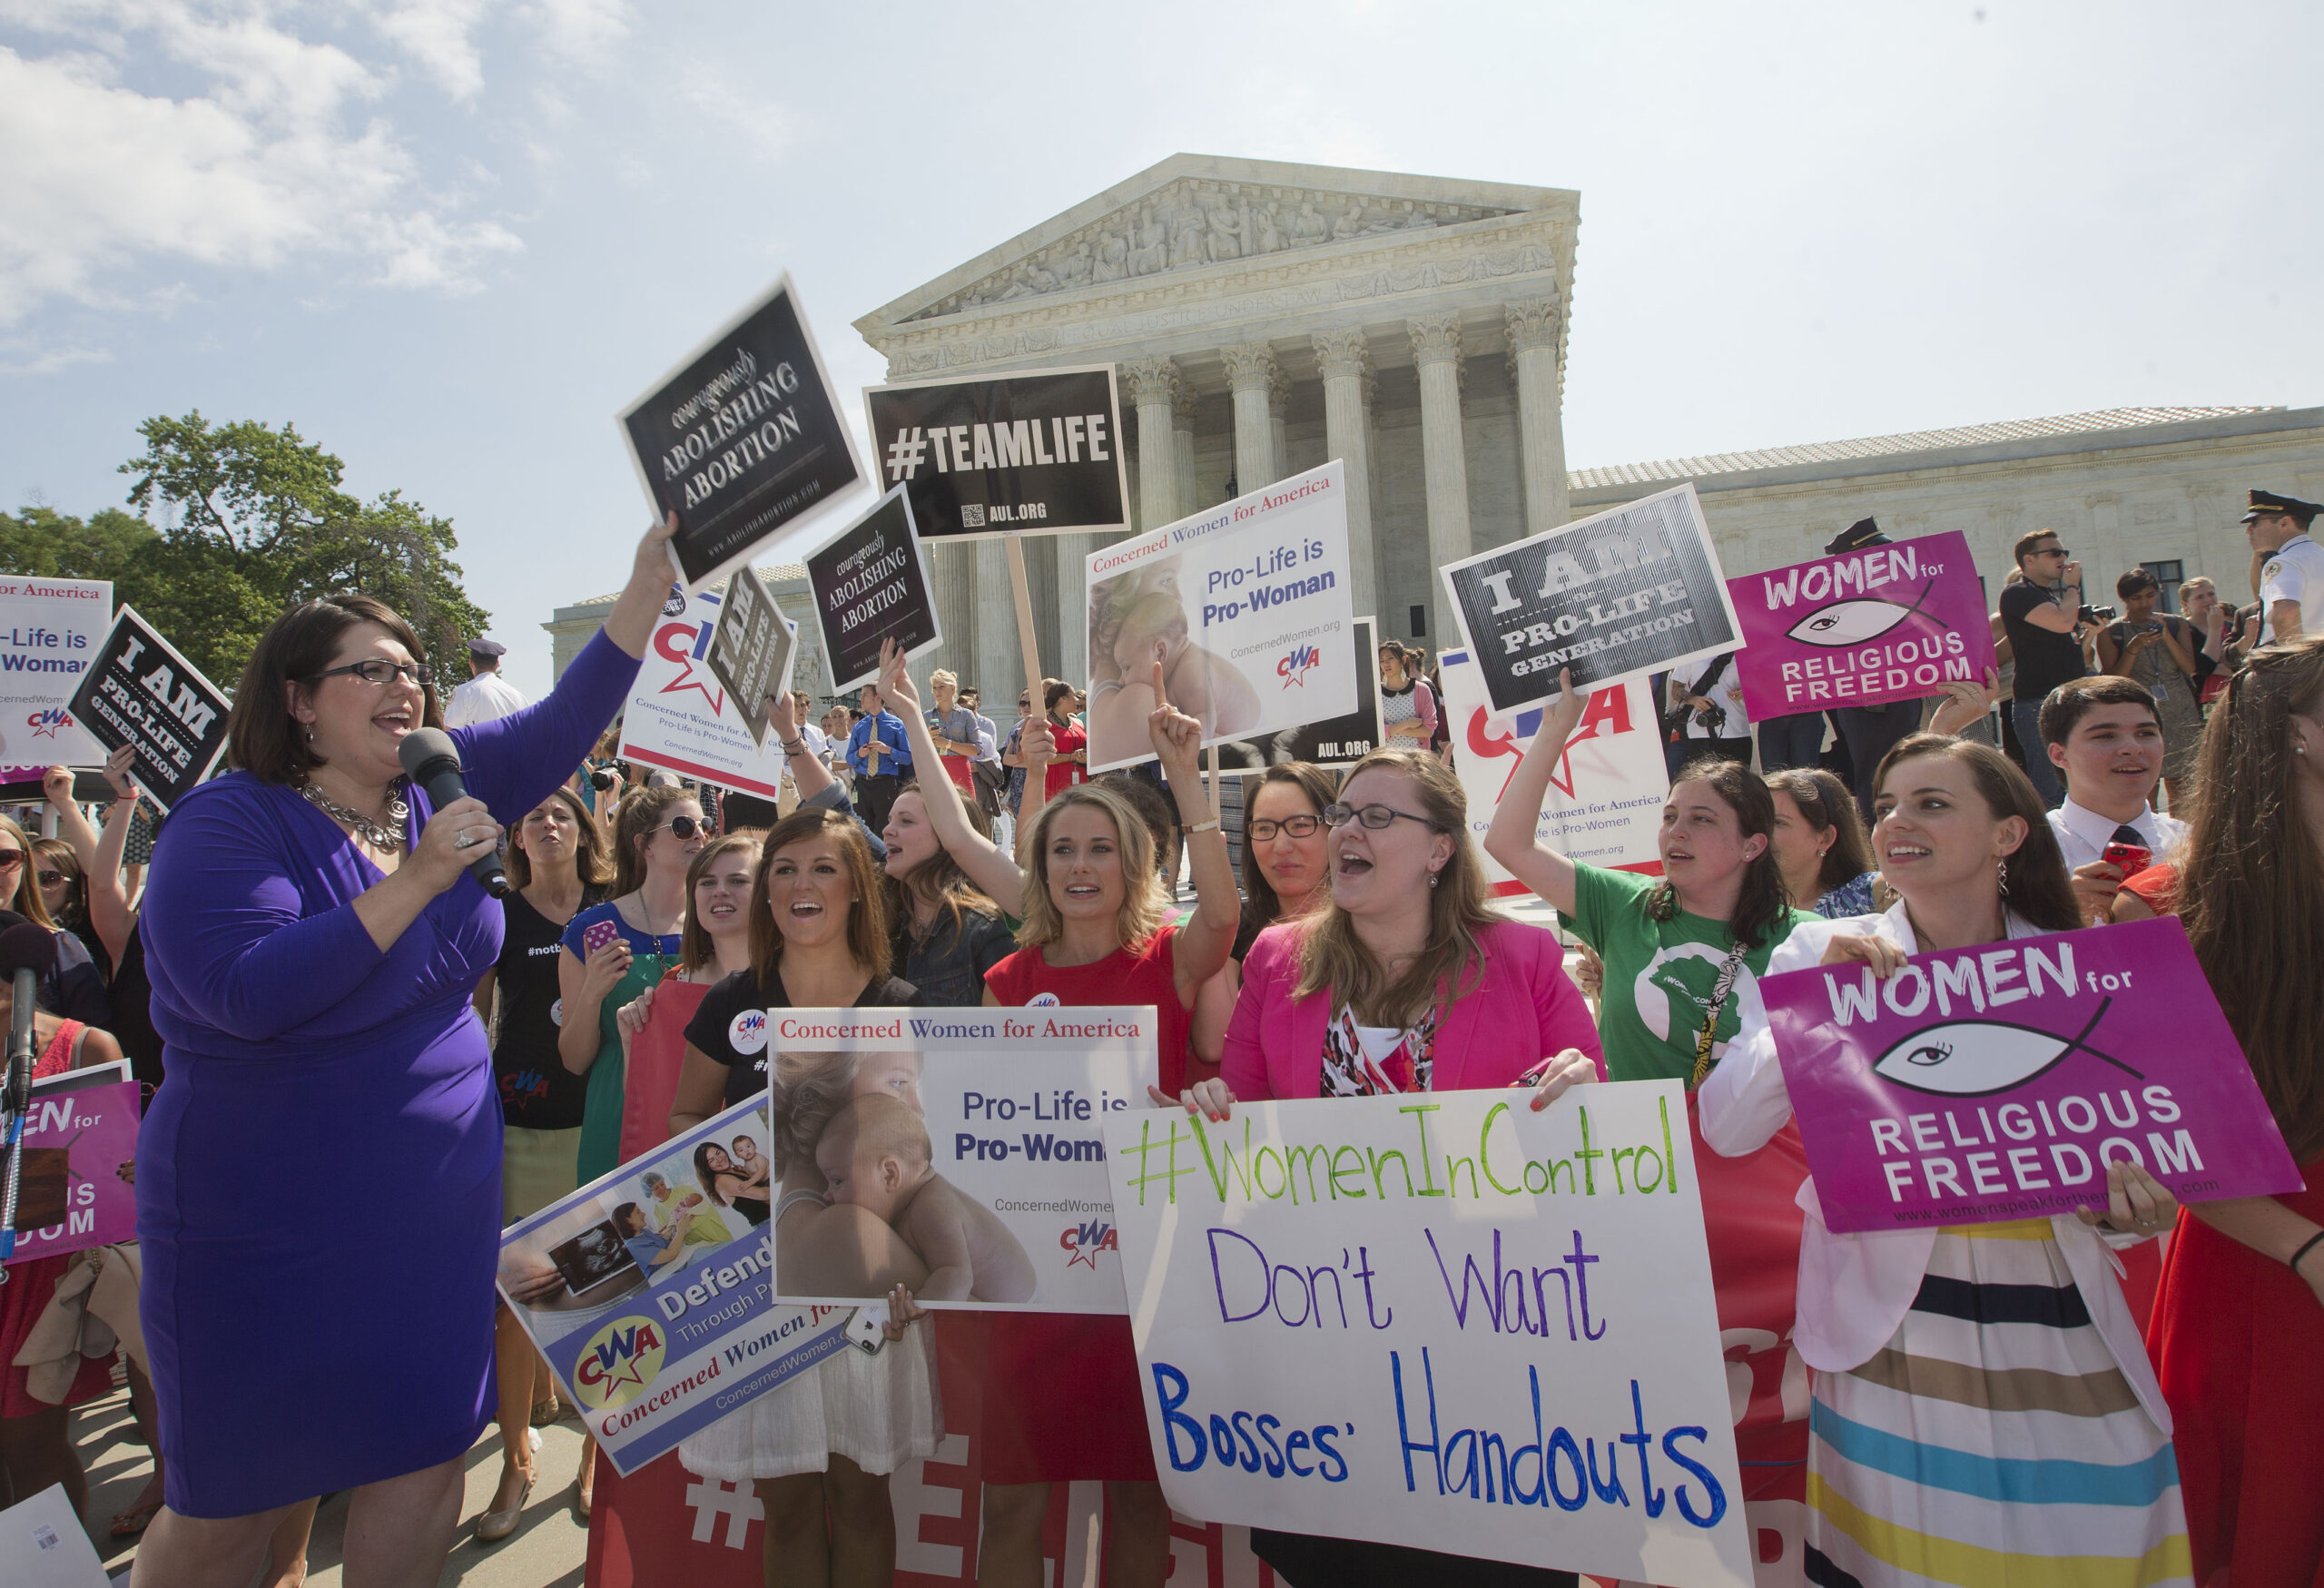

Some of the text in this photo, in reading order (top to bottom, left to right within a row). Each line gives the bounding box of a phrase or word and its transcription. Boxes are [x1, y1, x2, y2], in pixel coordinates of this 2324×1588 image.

[663, 361, 799, 481] ABOLISHING
[886, 414, 1109, 480] #TEAMLIFE
[684, 406, 802, 509] ABORTION
[990, 503, 1047, 522] AUL.ORG
[1093, 478, 1331, 574] Concerned Women for America
[829, 546, 907, 612] ABOLISHING
[836, 530, 885, 577] courageously
[1208, 538, 1324, 594] Pro-Life is
[1482, 518, 1673, 615] I AM
[1763, 546, 1945, 610] WOMEN for
[0, 584, 100, 599] or America
[842, 577, 908, 634] ABORTION
[1203, 570, 1335, 627] Pro-Woman
[1501, 578, 1689, 655] PRO-LIFE
[0, 628, 87, 648] -Life is
[717, 571, 754, 680] I AM
[1230, 619, 1341, 659] ConcernedWomen.org
[1510, 608, 1695, 676] GENERATION
[739, 608, 770, 705] PRO-LIFE
[750, 627, 778, 718] GENERATION
[1276, 643, 1320, 676] CWA
[1781, 631, 1965, 682] RELIGIOUS
[1786, 656, 1972, 703] FREEDOM
[117, 636, 145, 673] I
[140, 665, 218, 741] AM
[635, 697, 739, 735] Concerned Women for
[27, 707, 74, 728] CWA
[90, 695, 180, 784] GENERATION
[100, 675, 192, 769] PRO-LIFE
[659, 717, 692, 736] Pro-Life
[694, 727, 701, 737] is
[704, 729, 753, 752] Pro-Women
[1467, 683, 1635, 758] CA
[664, 739, 743, 768] ConcernedWomen.org
[1317, 740, 1371, 758] AUL.ORG
[1540, 795, 1661, 821] Women for America
[1551, 825, 1561, 836] is
[1562, 816, 1630, 834] Pro-Women
[1563, 844, 1624, 859] dWomen.org
[1823, 942, 2132, 1028] WOMEN for
[737, 1014, 765, 1031] CWA
[780, 1018, 1141, 1040] Concerned Women for America
[501, 1068, 550, 1098] CWA
[963, 1090, 1091, 1120] Pro-Life
[74, 1115, 102, 1129] for
[956, 1133, 1107, 1161] Pro-Wom
[1869, 1085, 2181, 1157] RELIGIOUS
[1120, 1095, 1678, 1206] #WomenInControl
[1881, 1129, 2205, 1204] FREEDOM
[1059, 1218, 1118, 1251] CWA
[655, 1236, 772, 1322] Defend
[1206, 1227, 1607, 1341] Don't Want
[675, 1294, 755, 1342] Through
[578, 1323, 662, 1386] CWA
[601, 1356, 722, 1437] Concerned
[724, 1315, 806, 1367] Women
[1151, 1362, 1355, 1483] Bosses'
[1390, 1346, 1728, 1529] Handouts
